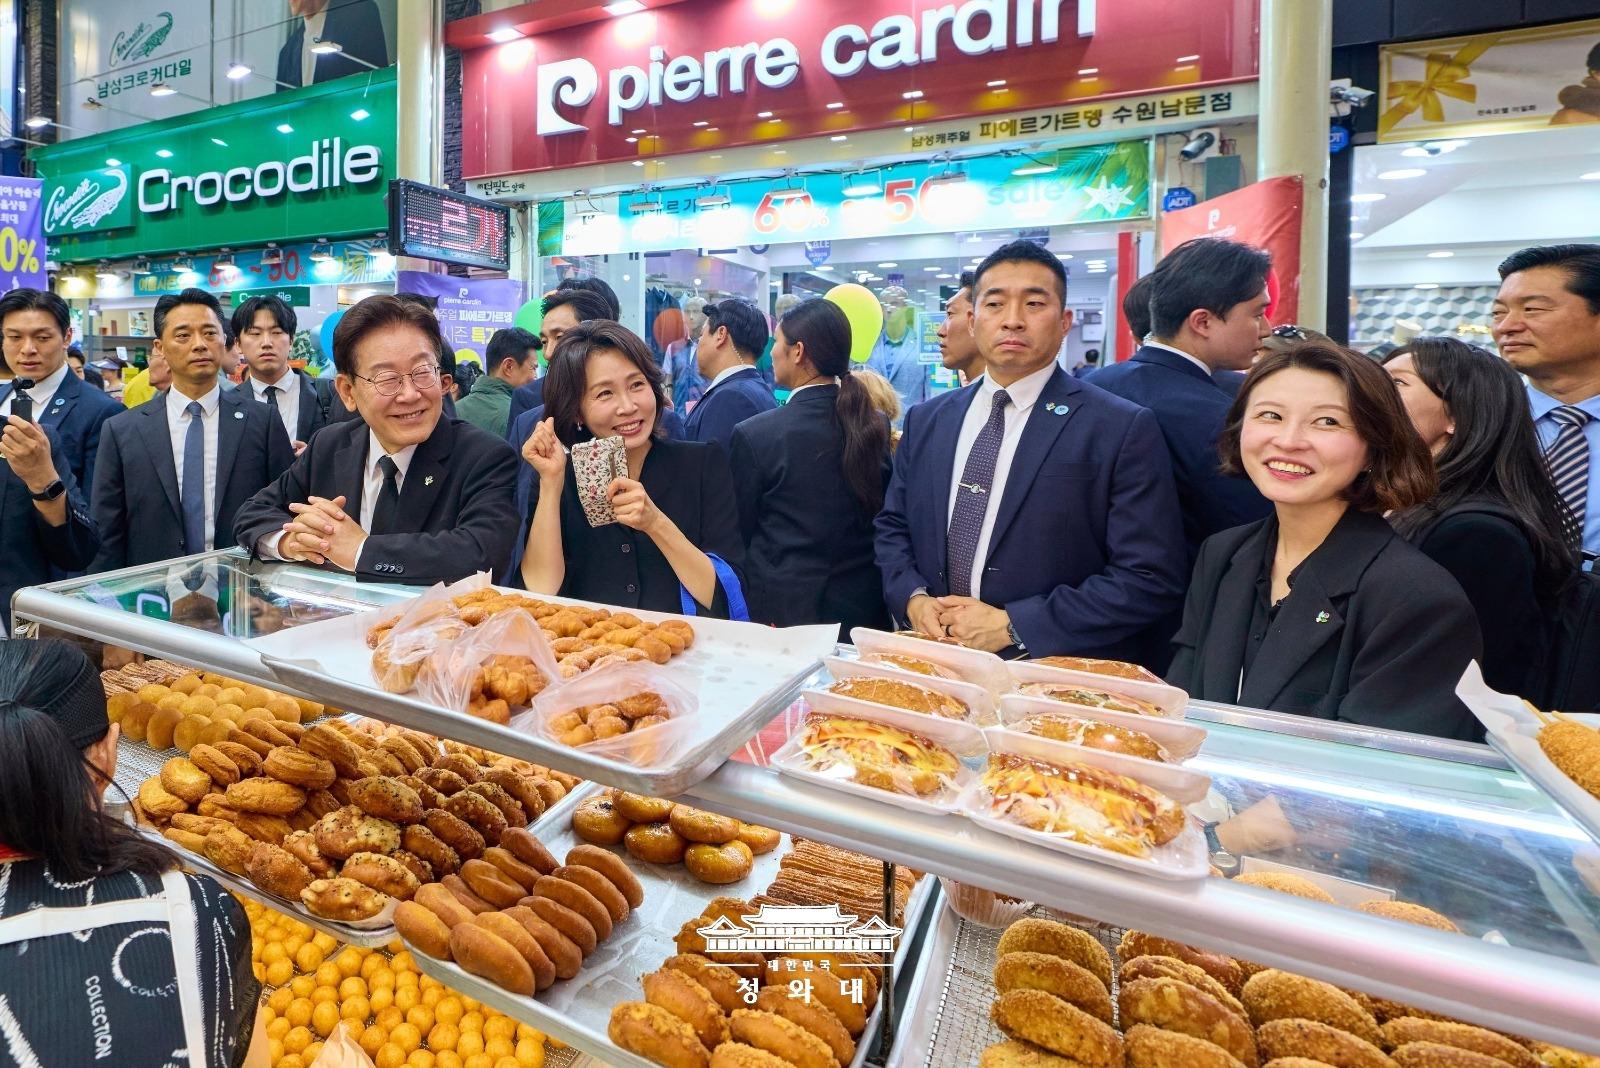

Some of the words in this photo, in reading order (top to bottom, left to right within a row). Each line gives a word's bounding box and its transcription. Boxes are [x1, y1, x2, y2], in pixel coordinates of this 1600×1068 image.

[97, 58, 192, 99] 남성크로커다일
[608, 37, 800, 125] pierre
[820, 0, 1096, 76] cardin
[911, 130, 970, 148] 남성캐주얼
[979, 108, 1103, 138] 피에르가르뎅
[1112, 91, 1232, 124] 수원남문점
[138, 136, 383, 214] Crocodile
[1169, 197, 1192, 208] ADT
[85, 975, 113, 1060] COLLECTION
